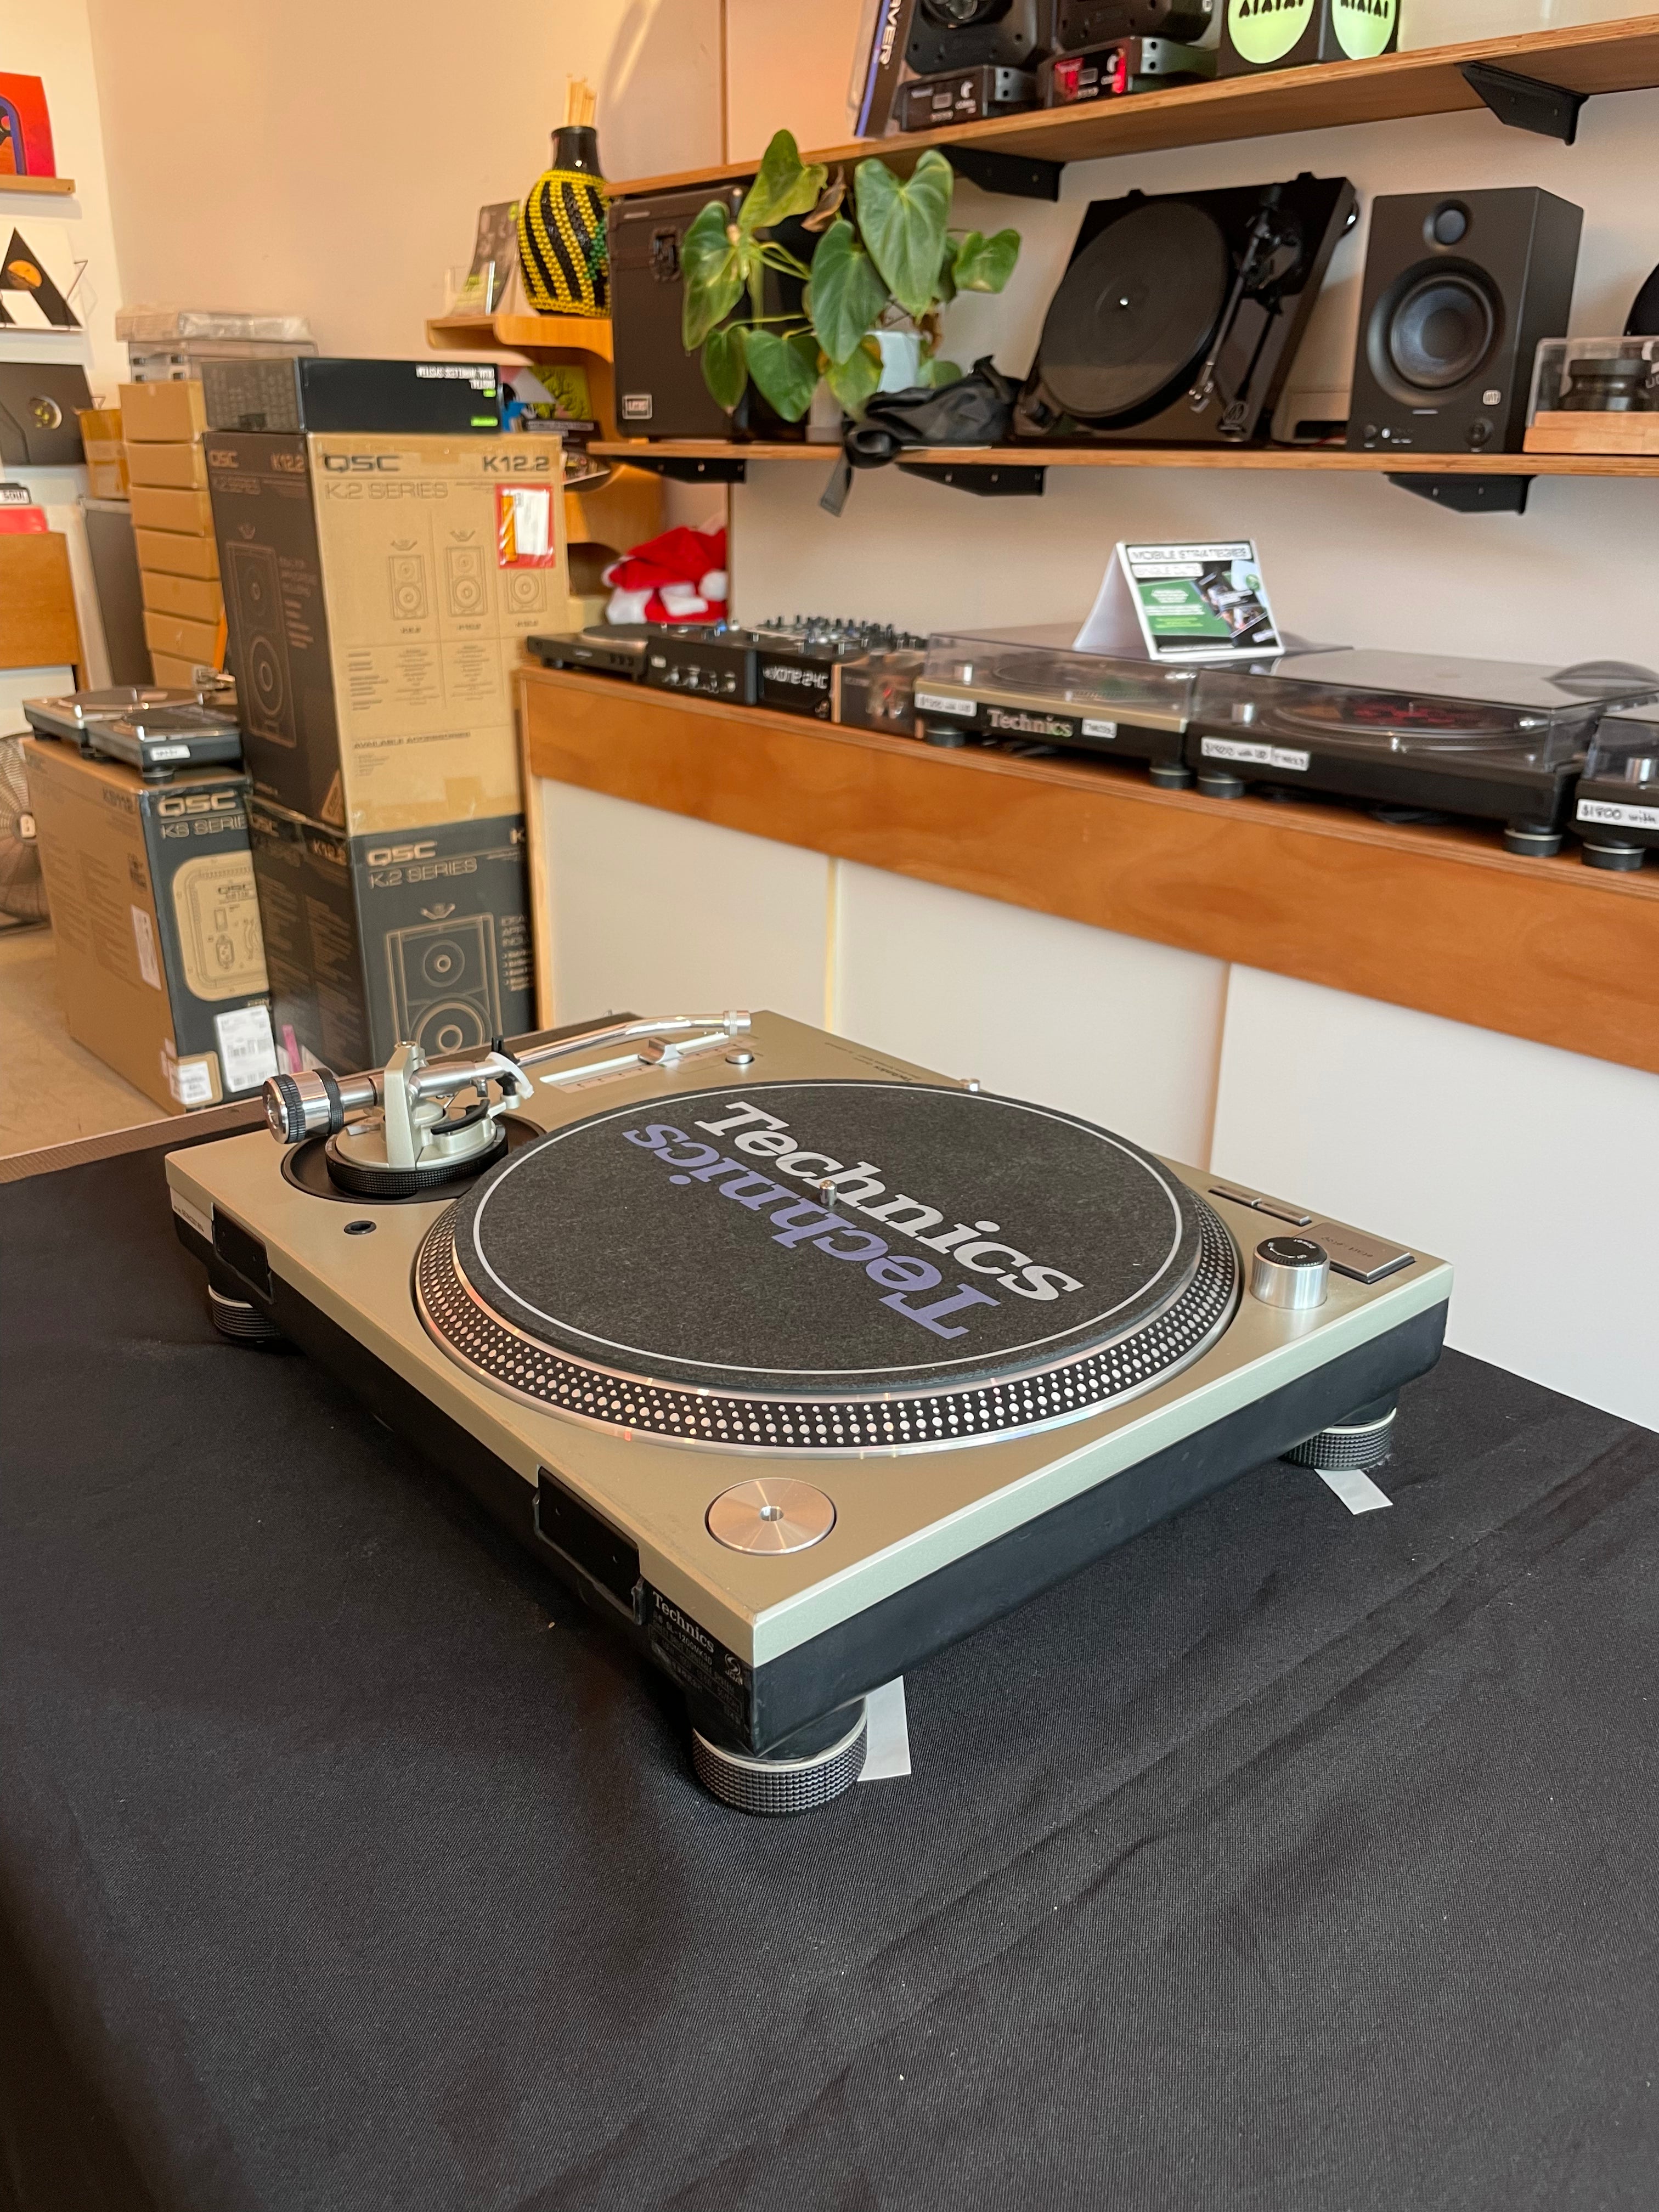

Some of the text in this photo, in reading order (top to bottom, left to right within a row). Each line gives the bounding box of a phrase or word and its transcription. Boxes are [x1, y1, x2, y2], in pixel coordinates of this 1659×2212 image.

[324, 455, 401, 472] QSC
[482, 455, 550, 472] K12.2
[368, 481, 448, 500] SERIES
[986, 708, 1074, 737] Technics
[159, 790, 236, 816] QSC
[367, 840, 438, 867] QSC
[407, 856, 477, 883] SERIES
[694, 1101, 1084, 1301] Technics
[622, 1124, 1001, 1340] Technics
[653, 1590, 714, 1654] Technics
